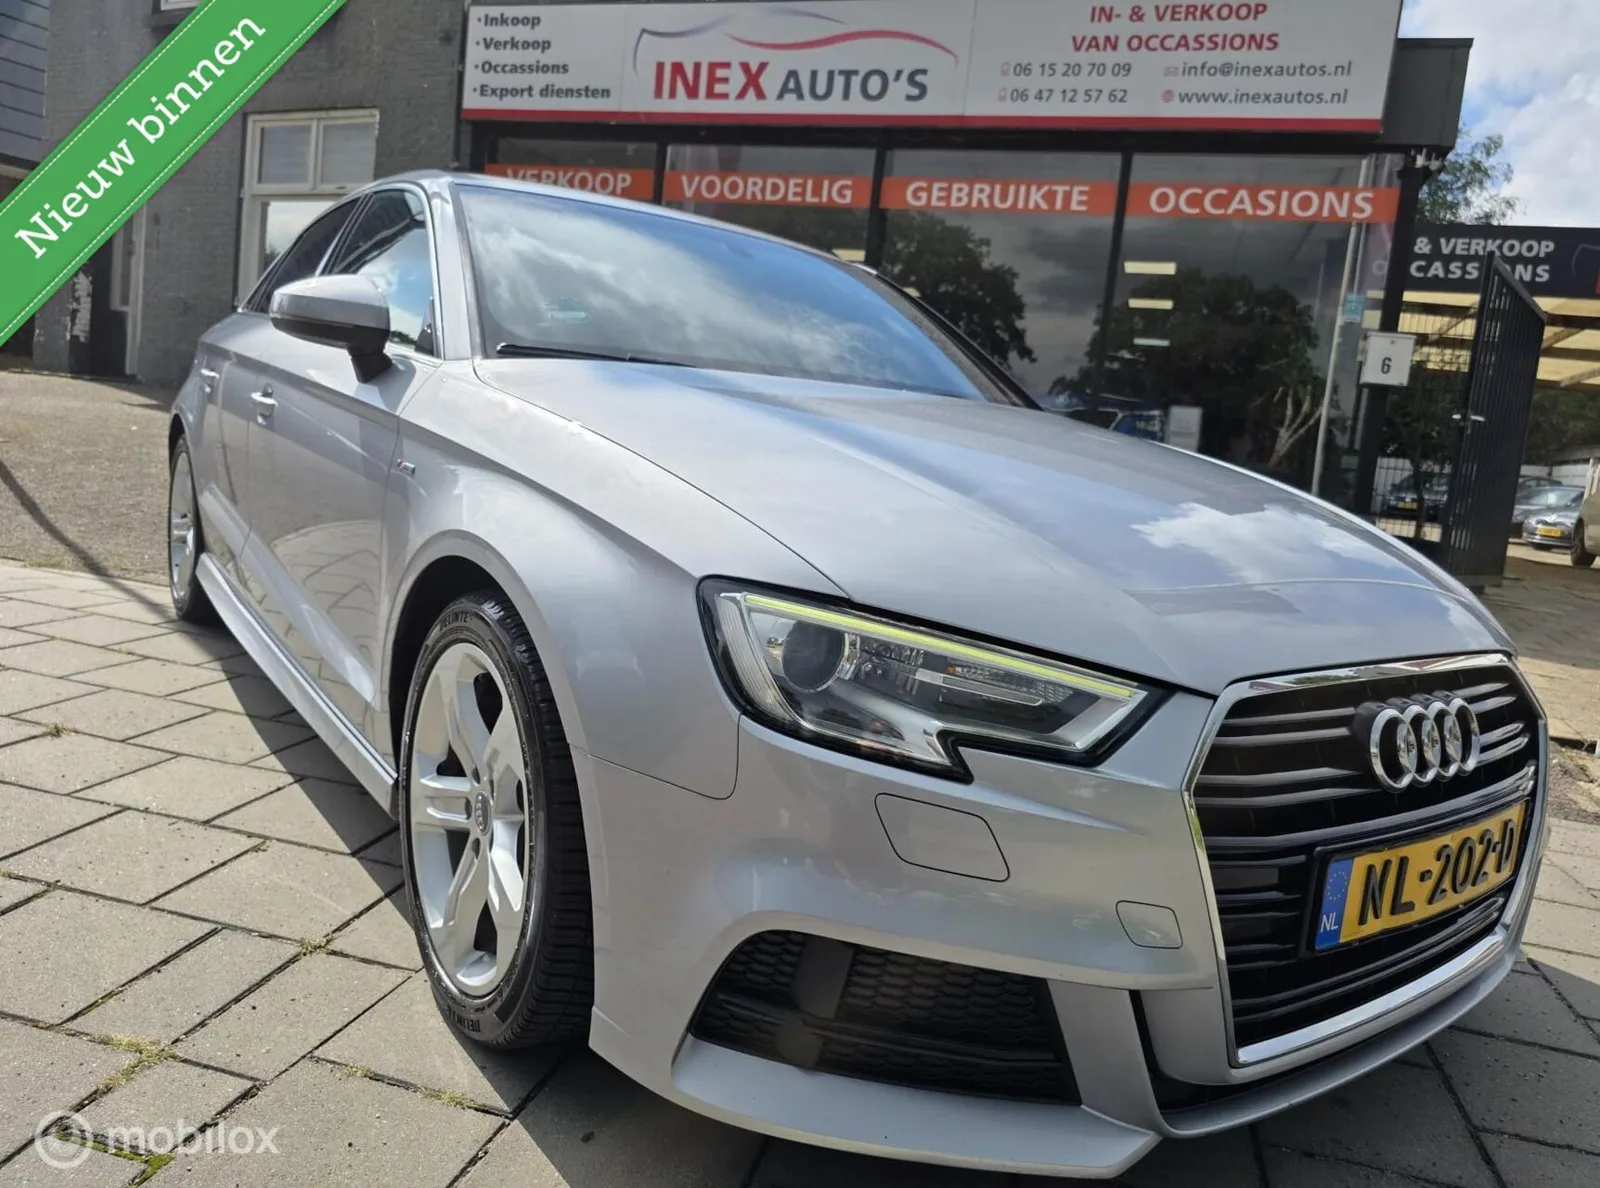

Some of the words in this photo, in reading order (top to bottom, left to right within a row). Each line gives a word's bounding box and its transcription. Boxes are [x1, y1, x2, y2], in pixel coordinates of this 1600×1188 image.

[483, 12, 541, 30] Inkoop
[1090, 5, 1122, 23] IN-
[1128, 4, 1146, 23] &
[1154, 2, 1268, 22] VERKOOP
[482, 36, 552, 54] Verkoop
[1071, 34, 1120, 53] VAN
[1126, 32, 1280, 53] OCCASSIONS
[480, 60, 570, 75] Occassions
[1012, 62, 1033, 77] 06
[1038, 62, 1057, 77] 15
[1061, 62, 1082, 77] 20
[1086, 62, 1107, 77] 70
[1111, 62, 1132, 77] 09
[1181, 60, 1353, 78] info@inexautos.nl
[653, 60, 770, 101] INEX
[775, 68, 929, 102] AUTO'S
[479, 83, 534, 100] Export
[539, 83, 612, 99] diensten
[1010, 88, 1029, 103] 06
[1033, 88, 1054, 103] 47
[1059, 88, 1078, 103] 12
[1083, 88, 1103, 103] 57
[1107, 88, 1128, 103] 62
[1177, 88, 1349, 104] www.inexautos.nl
[680, 175, 854, 204] VOORDELIG
[905, 181, 1091, 212] GEBRUIKTE
[1149, 186, 1375, 219] OCCASIONS
[1412, 236, 1433, 255] &
[1439, 237, 1556, 258] VERKOOP
[1380, 356, 1392, 375] 6
[1357, 818, 1516, 927] NL-202-D
[1320, 911, 1339, 933] NL
